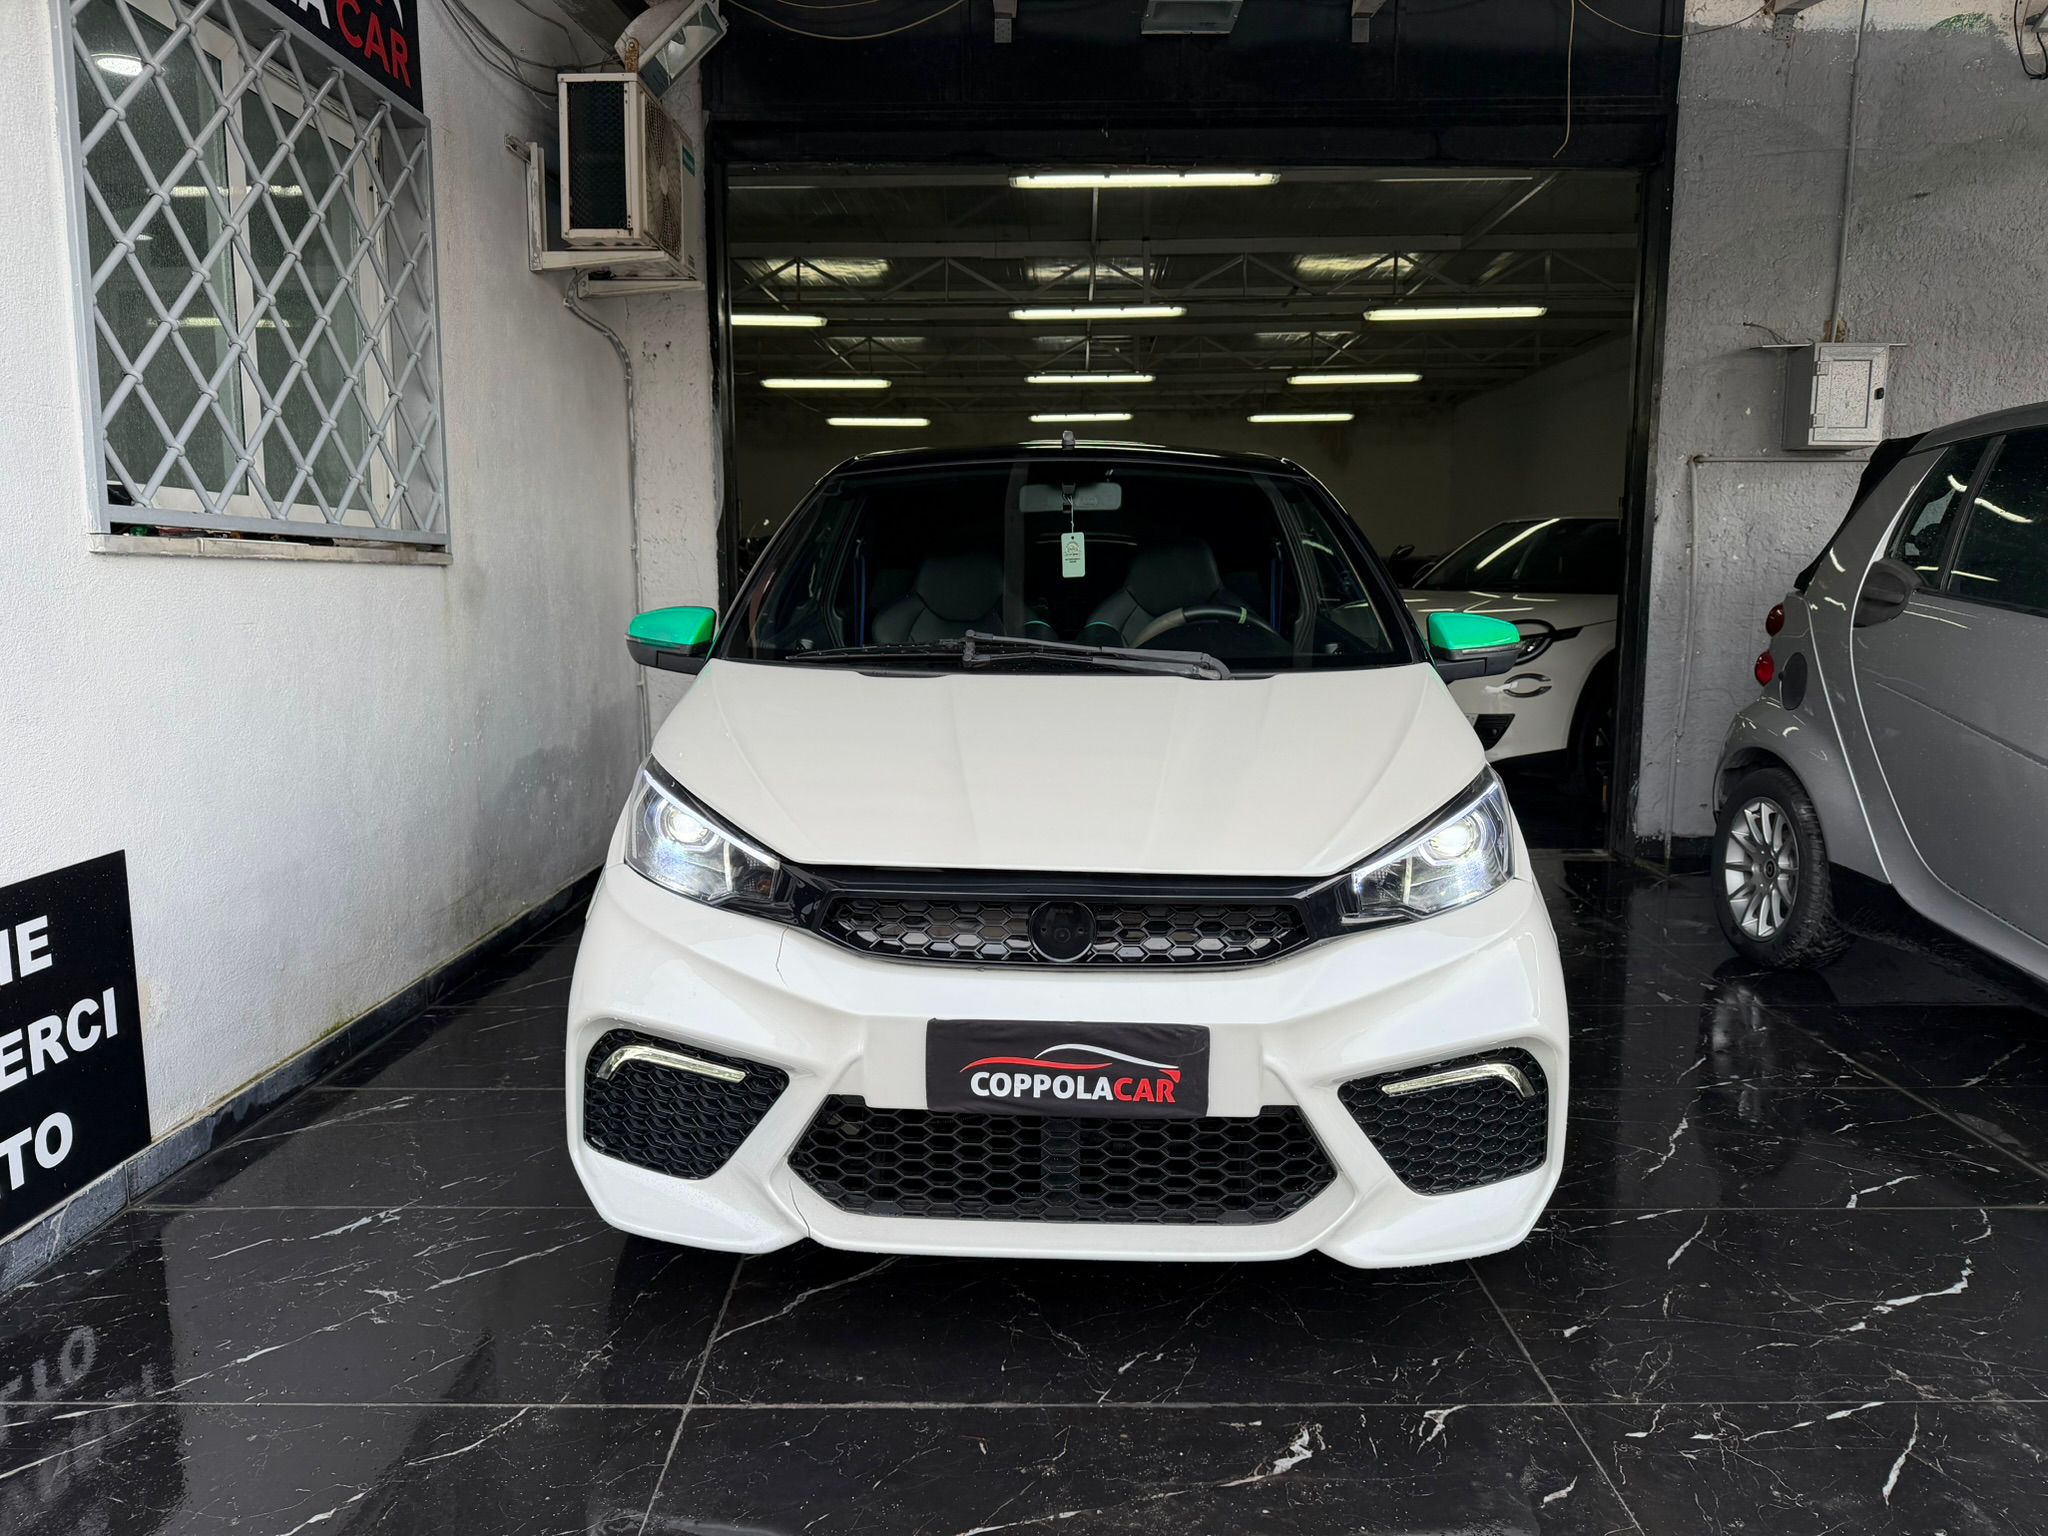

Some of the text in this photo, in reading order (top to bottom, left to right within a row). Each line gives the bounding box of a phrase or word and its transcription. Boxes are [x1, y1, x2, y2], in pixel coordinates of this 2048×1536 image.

[0, 986, 118, 1092] ERCI
[970, 1071, 1176, 1103] COPPOLACAR
[0, 1111, 73, 1191] TO
